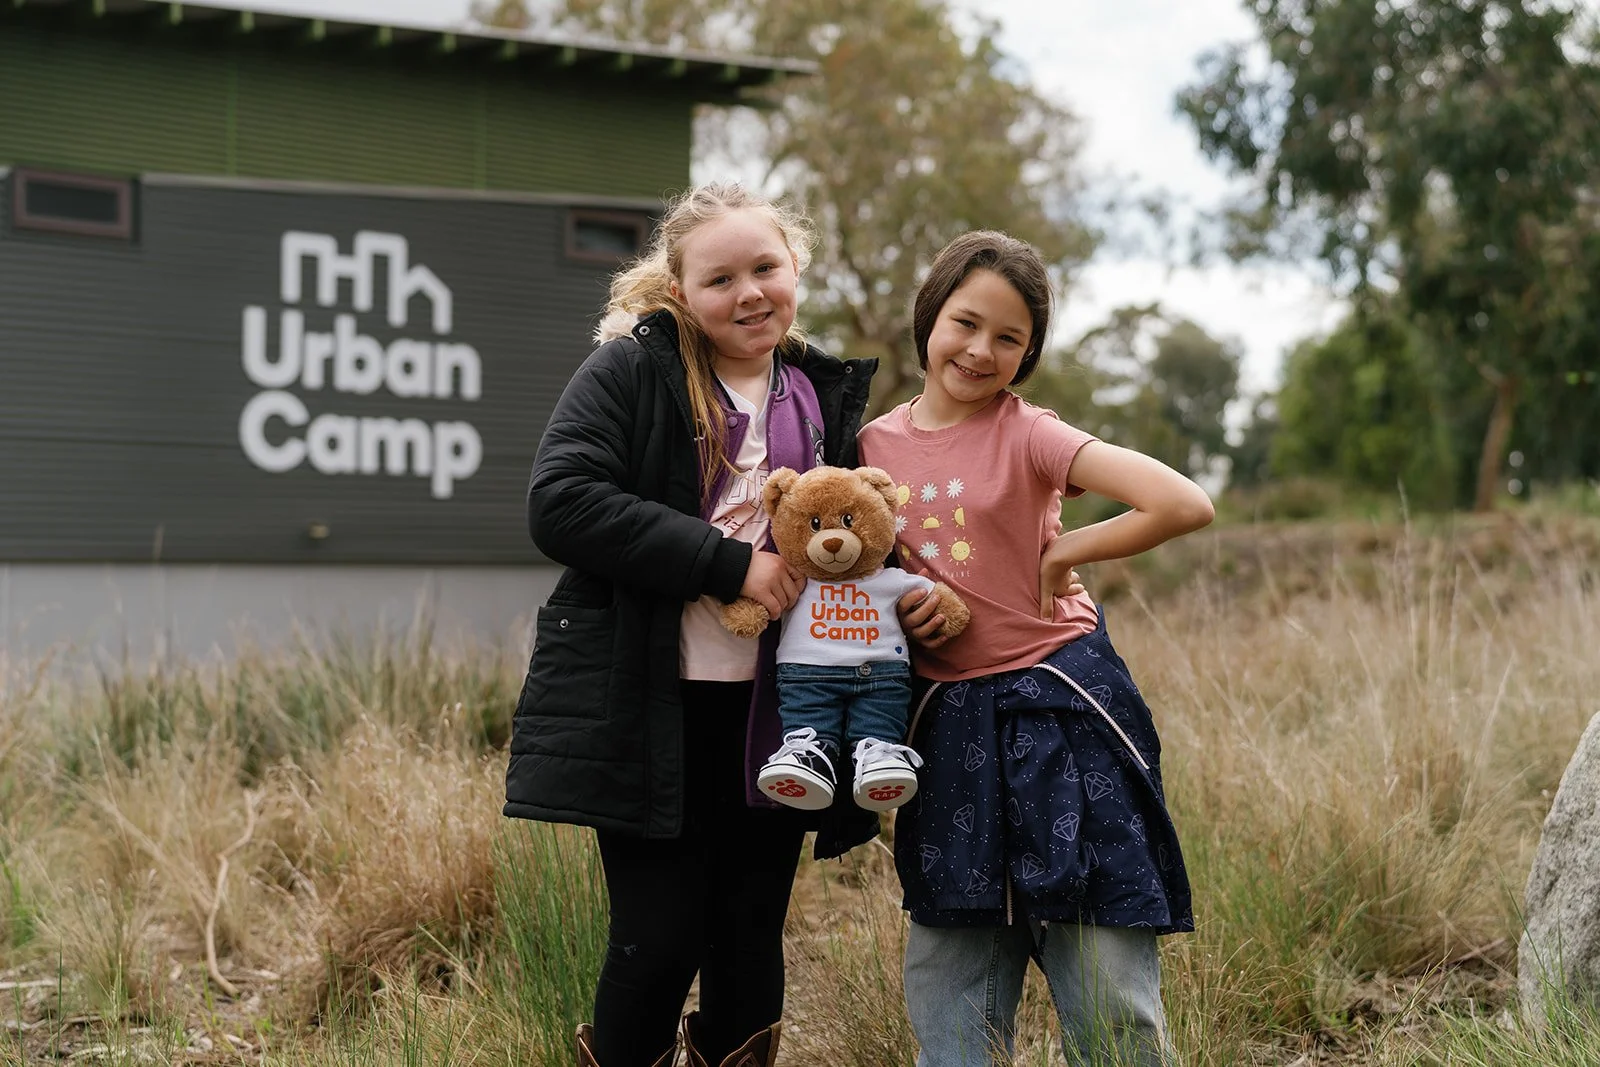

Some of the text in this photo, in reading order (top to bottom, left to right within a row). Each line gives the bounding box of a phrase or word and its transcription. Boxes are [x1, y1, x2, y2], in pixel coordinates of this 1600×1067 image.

[241, 305, 482, 401] Urban
[239, 389, 483, 498] Camp
[809, 621, 880, 645] Camp
[811, 602, 880, 621] Urban
